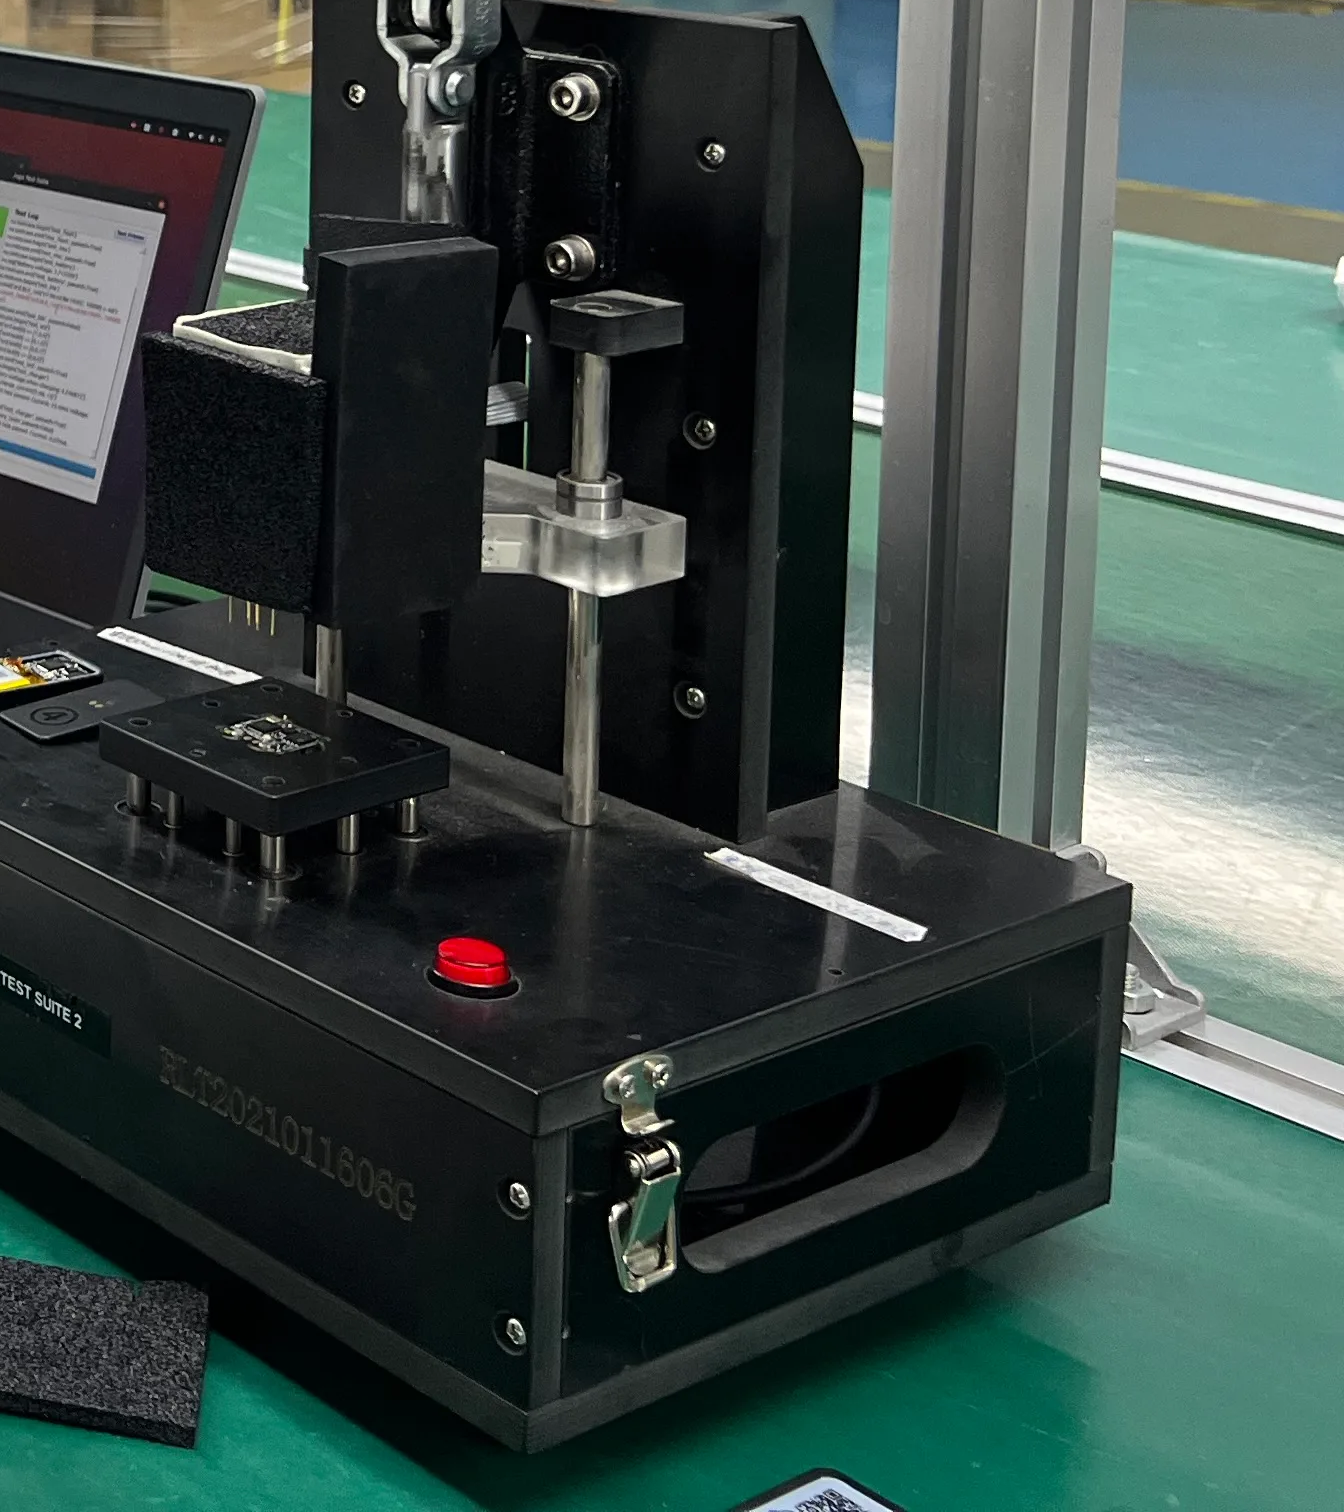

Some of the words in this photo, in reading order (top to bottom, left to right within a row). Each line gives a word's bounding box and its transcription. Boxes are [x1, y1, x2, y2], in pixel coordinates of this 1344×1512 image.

[0, 970, 33, 1001] TEST
[34, 991, 74, 1025] SUITE
[73, 1013, 83, 1030] 2
